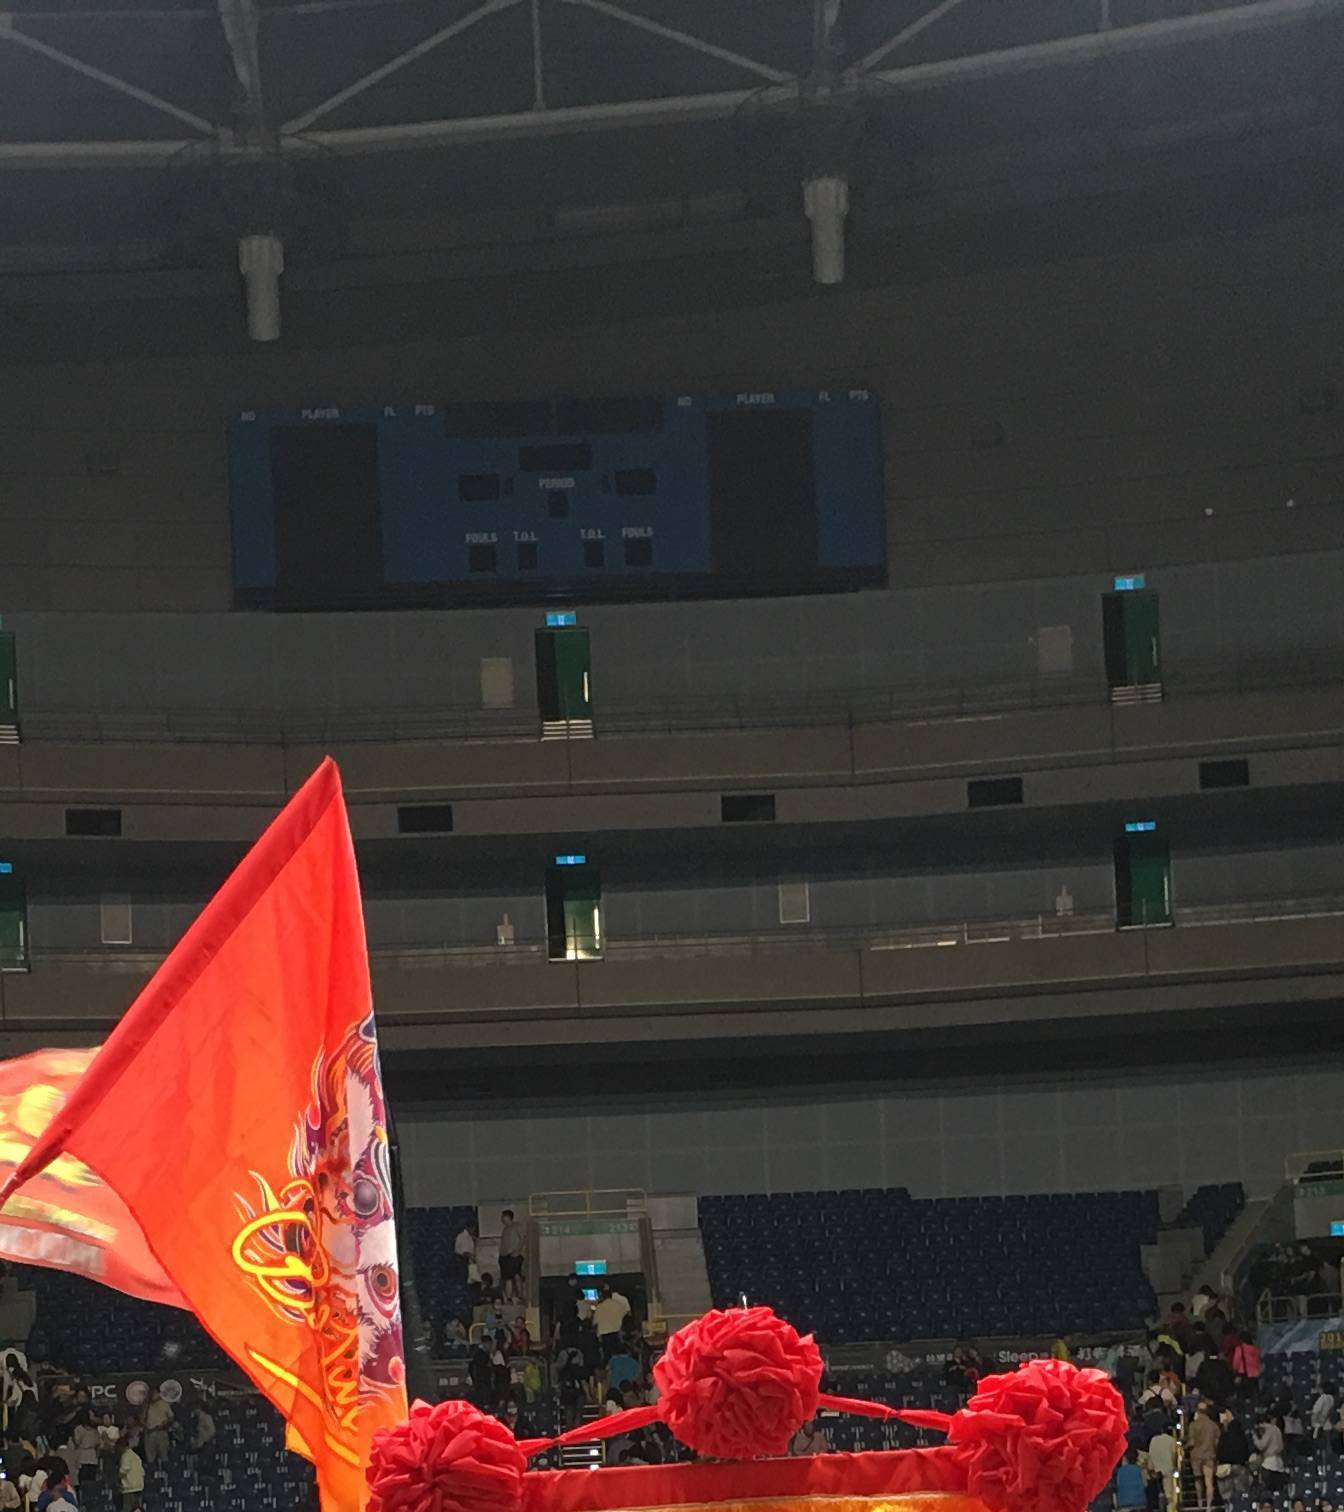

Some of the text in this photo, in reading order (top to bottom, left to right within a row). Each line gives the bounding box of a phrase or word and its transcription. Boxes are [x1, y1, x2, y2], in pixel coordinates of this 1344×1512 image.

[737, 392, 776, 404] PLAYER
[849, 390, 869, 401] PTS
[301, 408, 340, 420] PLAYER
[415, 405, 435, 417] PTS
[465, 533, 498, 544] FOULS
[621, 527, 653, 539] FOULS
